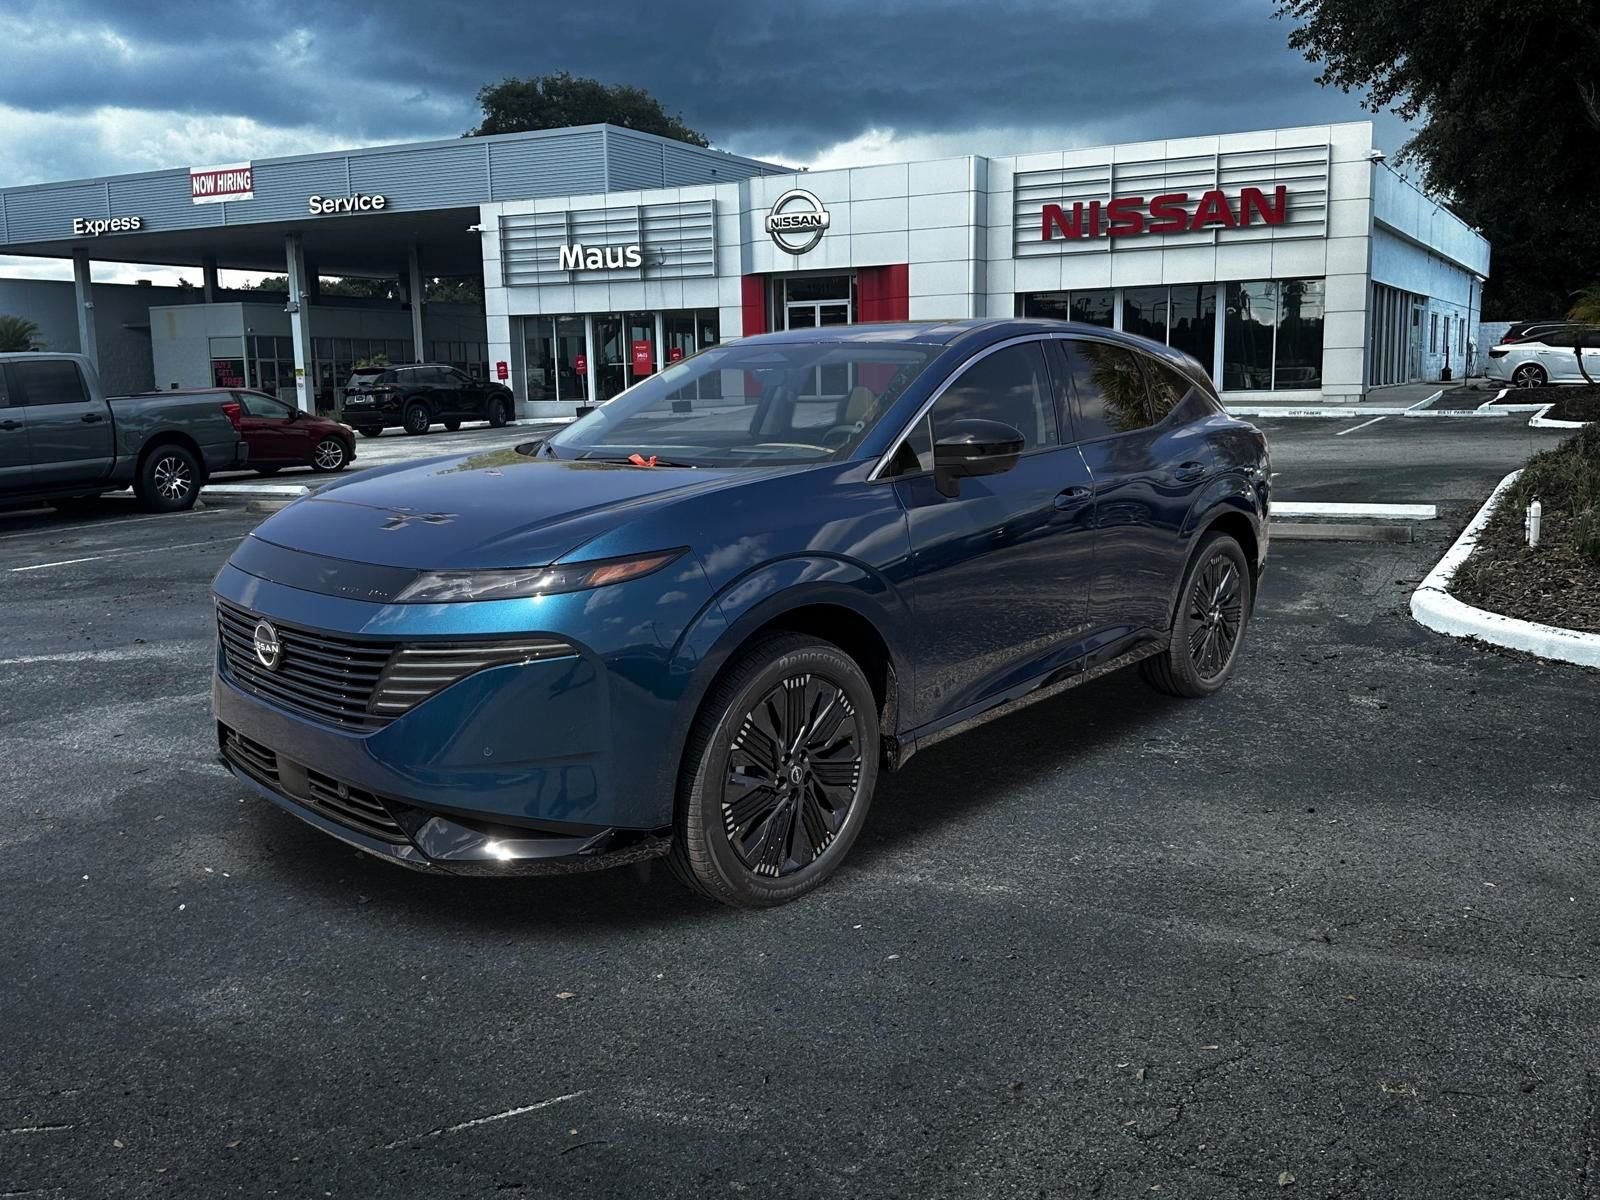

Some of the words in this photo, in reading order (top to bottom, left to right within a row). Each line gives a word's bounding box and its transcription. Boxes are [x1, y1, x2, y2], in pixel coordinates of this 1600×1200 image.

[192, 174, 215, 195] NOW
[217, 171, 251, 192] HIRING
[309, 192, 385, 215] Service
[1041, 185, 1287, 241] NISSAN
[73, 216, 141, 237] Express
[770, 215, 822, 228] NISSAN
[559, 243, 642, 271] Maus
[223, 377, 243, 386] FREE
[256, 641, 278, 652] SSAN
[779, 653, 852, 673] BRIDGESTONE
